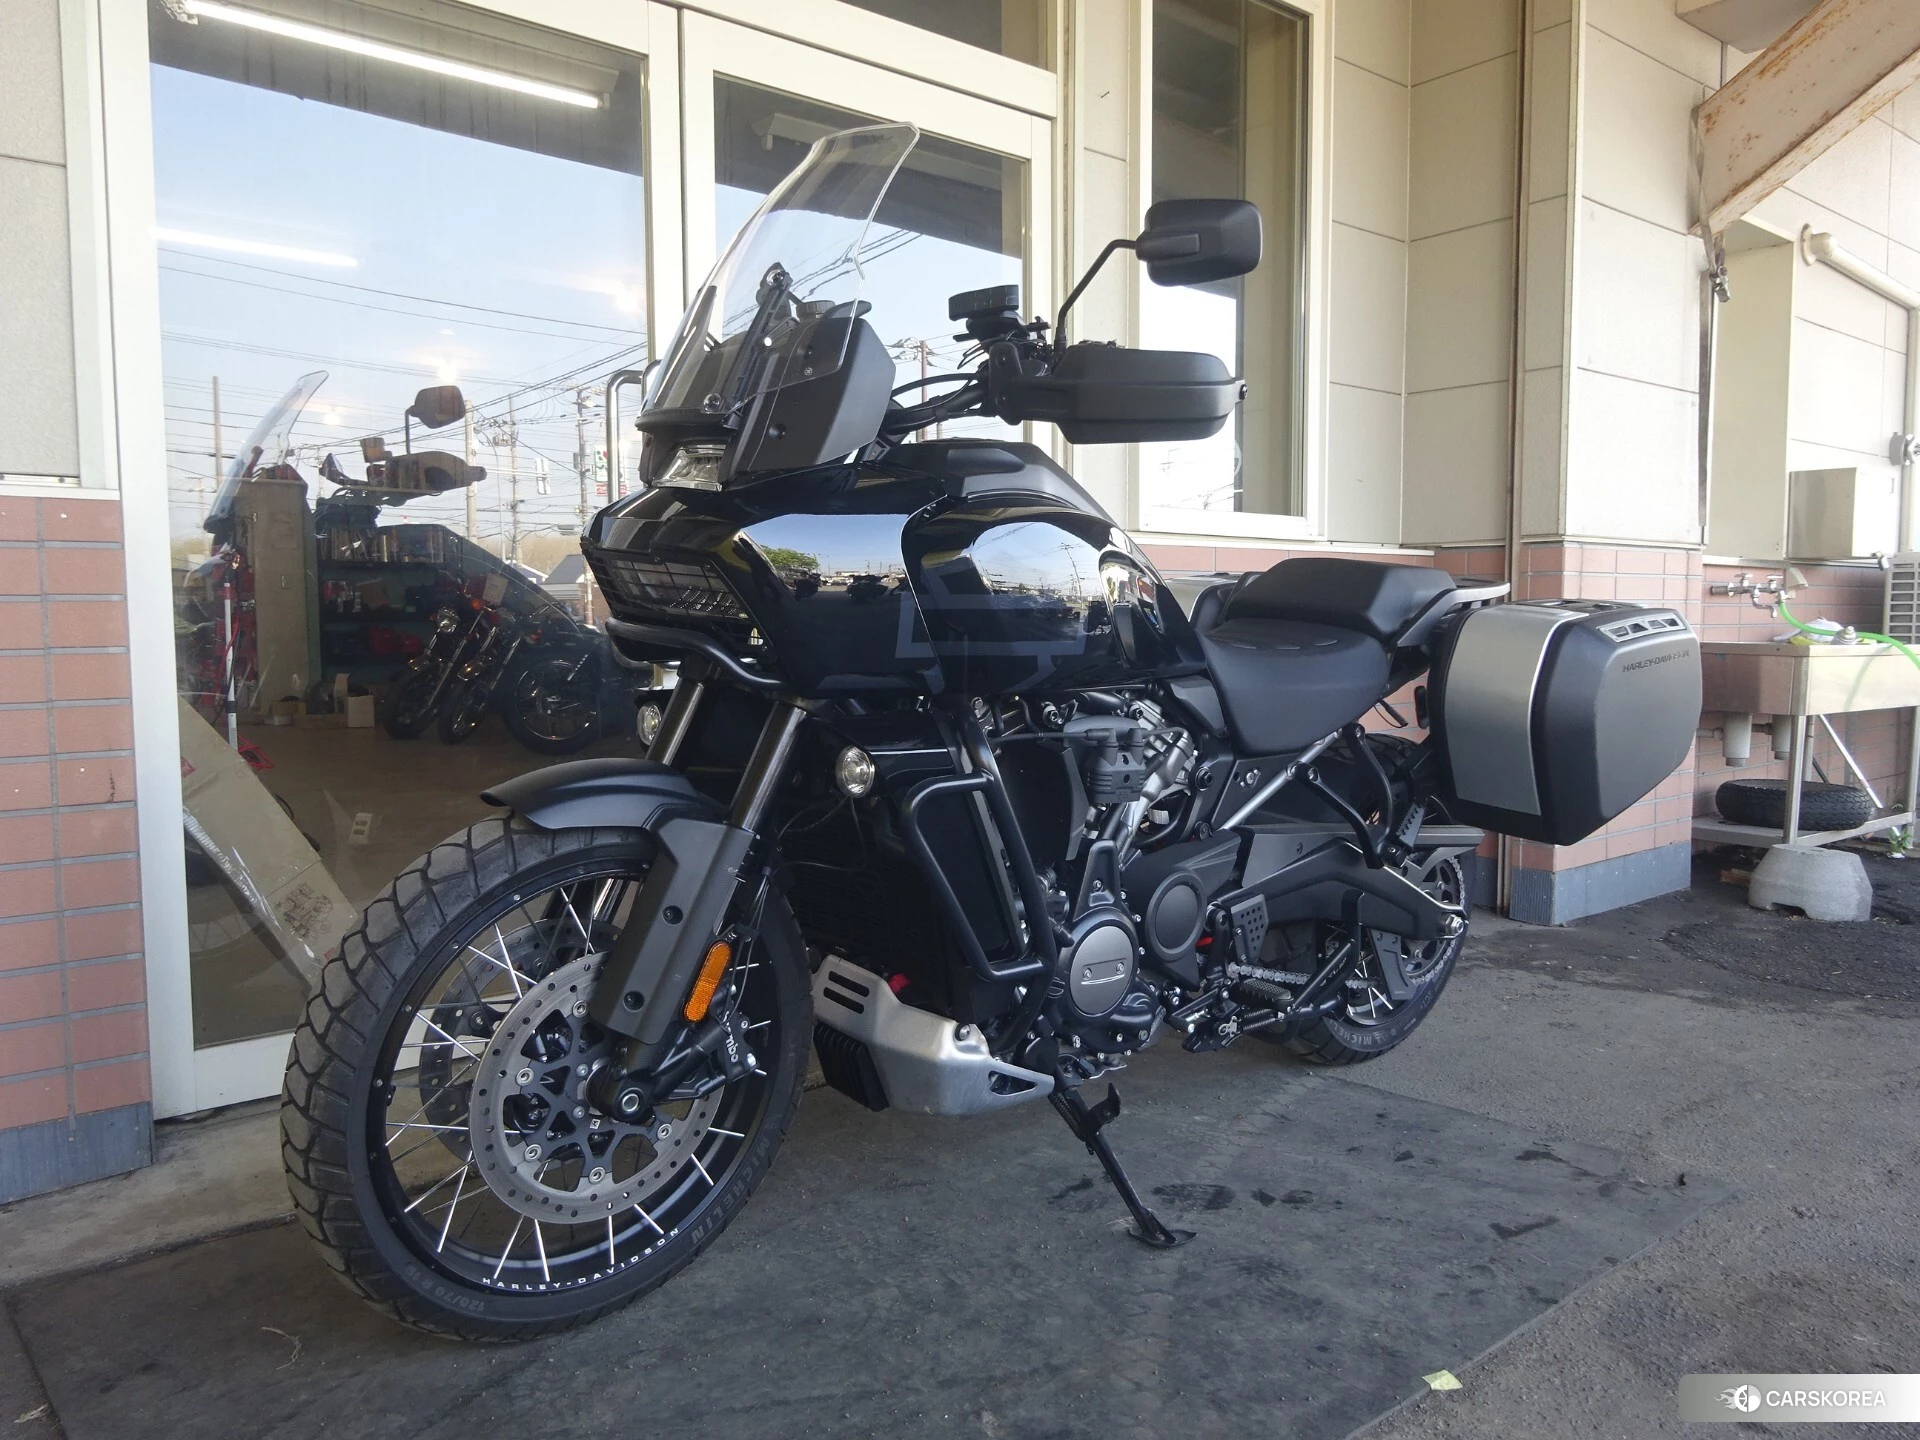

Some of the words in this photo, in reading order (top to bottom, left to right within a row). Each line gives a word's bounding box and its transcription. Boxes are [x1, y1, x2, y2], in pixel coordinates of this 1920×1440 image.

[1622, 649, 1689, 672] HARLEY-DAVIDSON
[691, 1138, 771, 1245] MICHELIN
[482, 1227, 680, 1291] HARLEY-DAVIDSON
